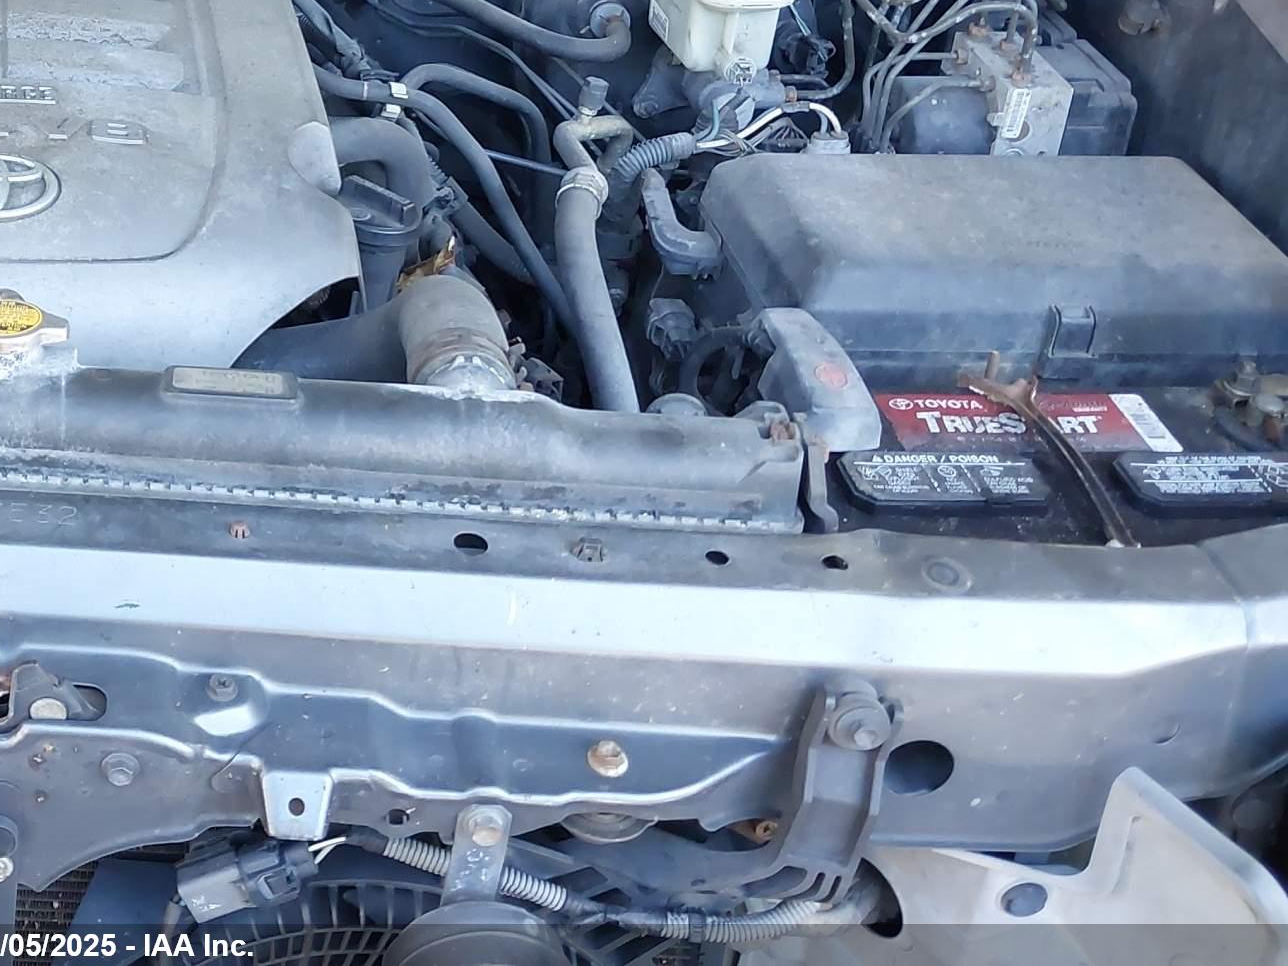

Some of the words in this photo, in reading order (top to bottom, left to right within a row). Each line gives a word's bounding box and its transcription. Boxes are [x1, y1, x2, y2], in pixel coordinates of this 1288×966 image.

[915, 398, 983, 410] TOYOTA
[883, 454, 937, 464] DANGER
[949, 454, 999, 464] POISON
